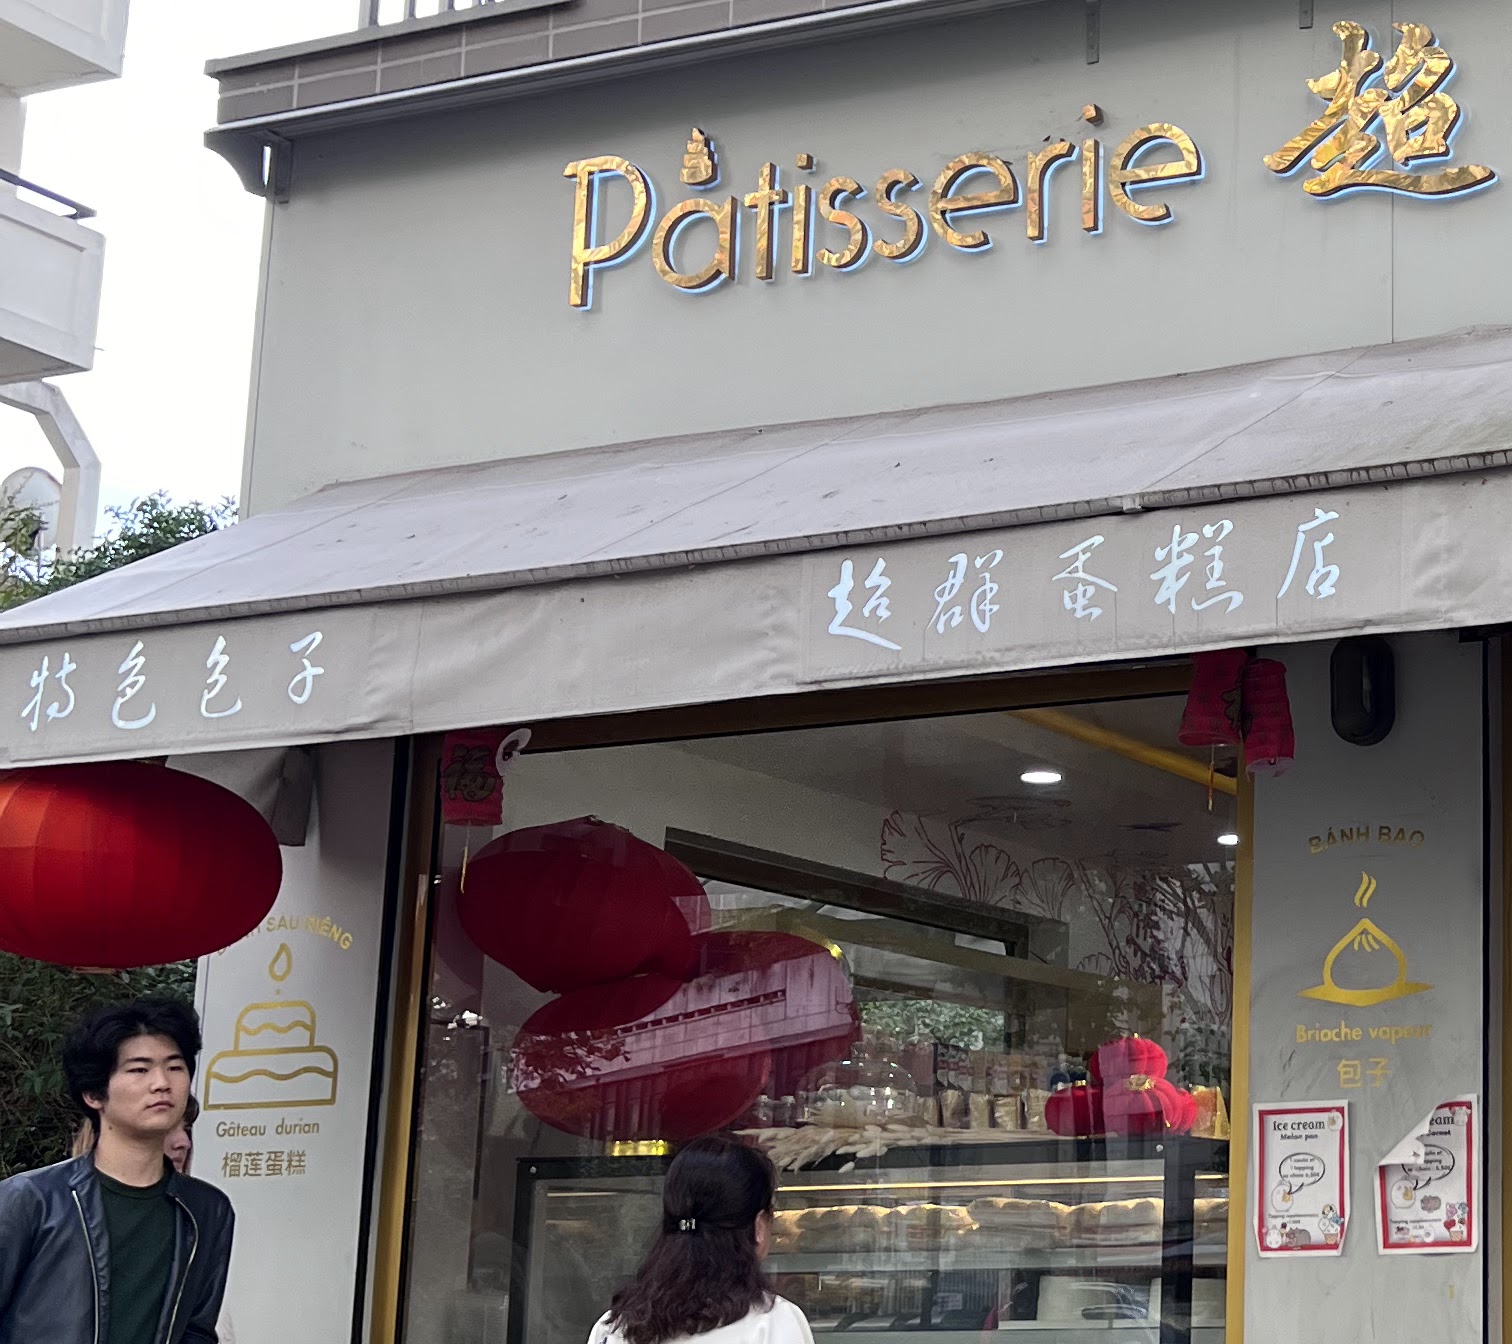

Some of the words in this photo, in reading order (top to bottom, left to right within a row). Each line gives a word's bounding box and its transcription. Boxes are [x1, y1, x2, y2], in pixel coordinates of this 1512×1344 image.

[1378, 825, 1425, 849] BAO
[1296, 1020, 1362, 1043] Brioche
[1337, 1057, 1391, 1089] 包子
[216, 1121, 266, 1138] Gâteau
[275, 1117, 319, 1136] durian
[1291, 1120, 1325, 1131] cream
[221, 1150, 306, 1178] 榴莲蛋糕
